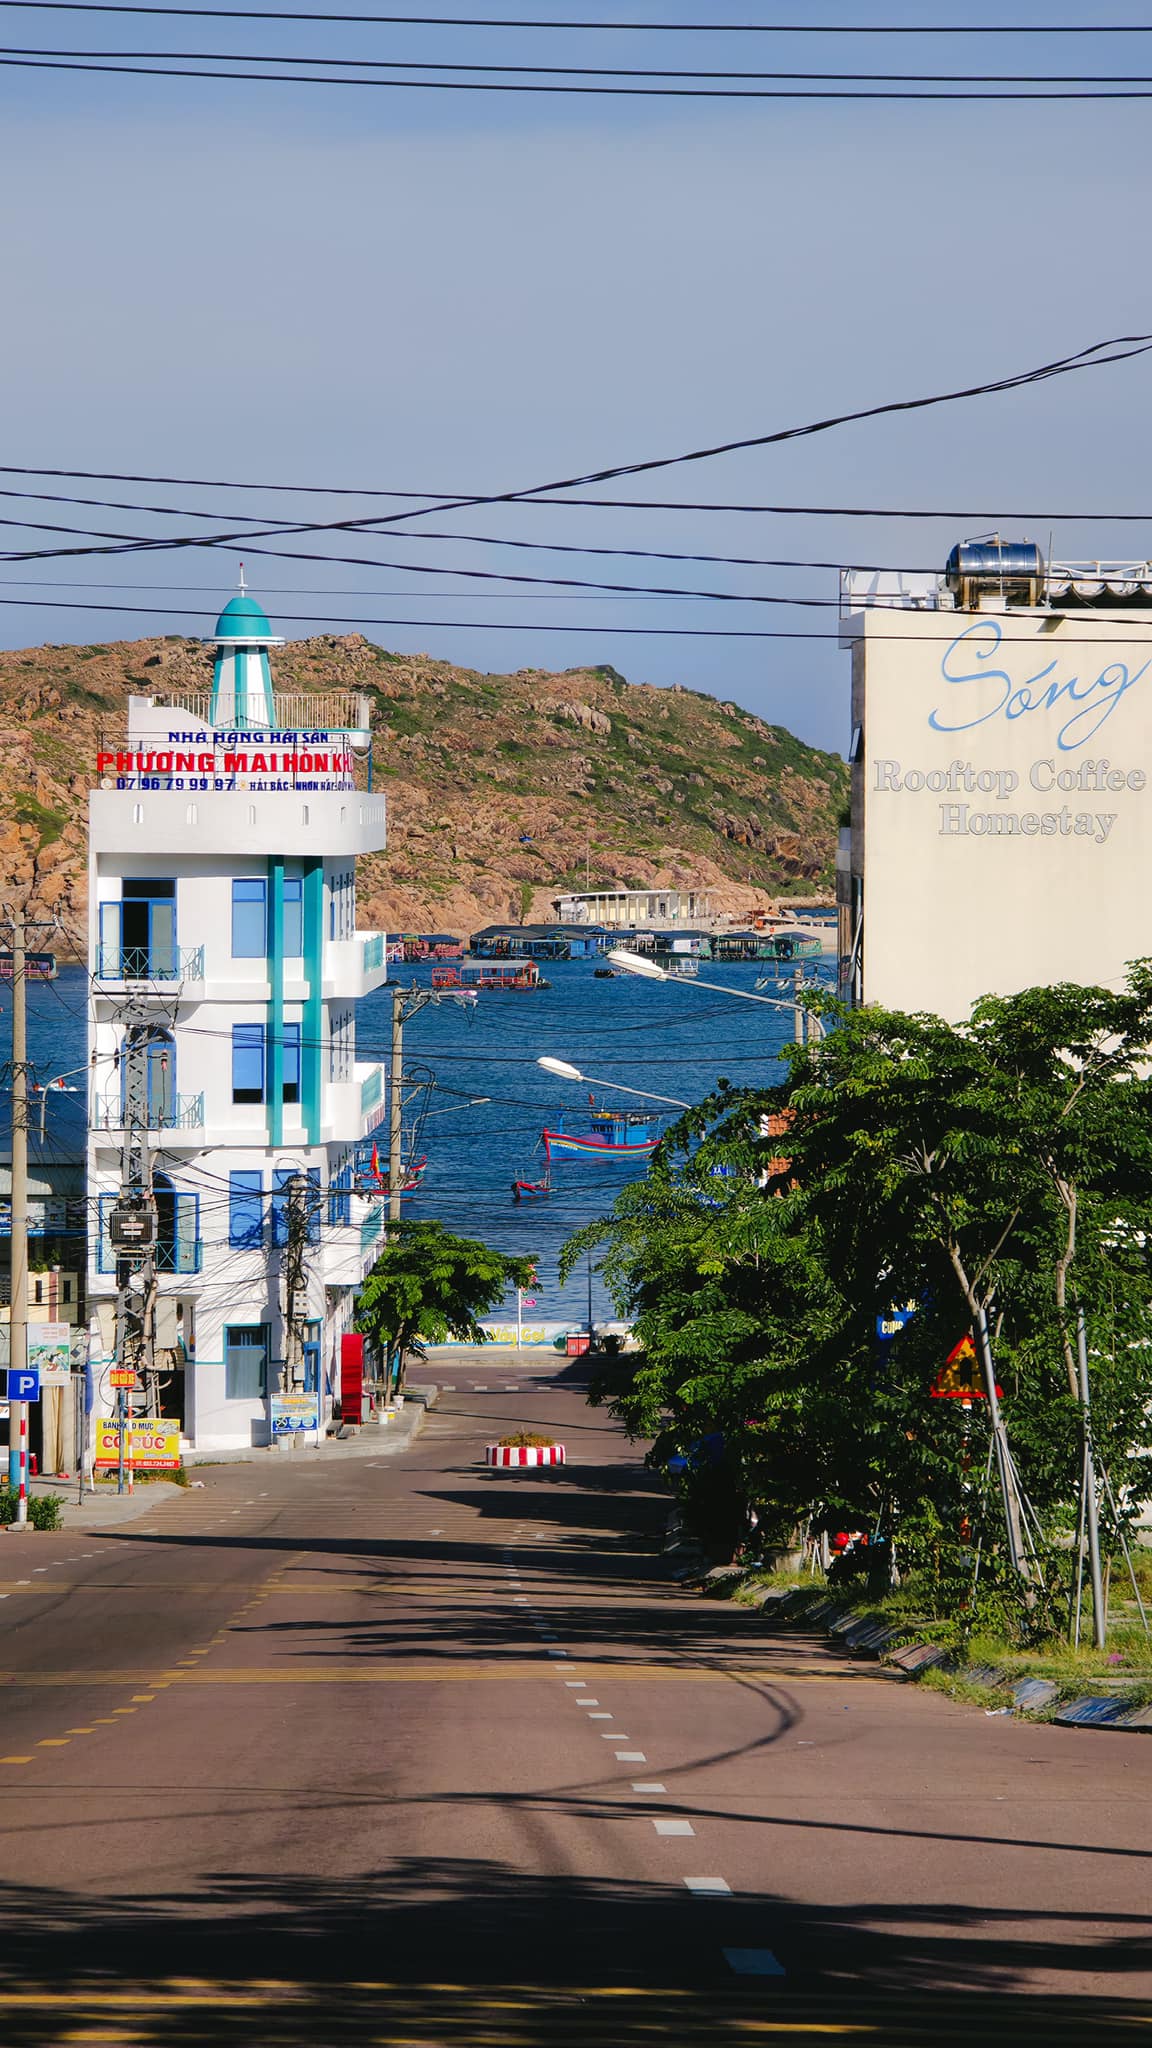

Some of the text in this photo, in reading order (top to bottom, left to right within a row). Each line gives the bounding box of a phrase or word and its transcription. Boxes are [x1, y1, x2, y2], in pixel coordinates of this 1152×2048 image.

[928, 620, 1151, 751] Sóng
[168, 728, 207, 743] NHÀ
[97, 751, 214, 773] PHƯƠNG
[223, 752, 277, 773] MAI
[283, 746, 328, 773] HÒN
[141, 777, 160, 790] 96
[164, 777, 184, 790] 79
[189, 778, 208, 790] 99
[215, 778, 235, 790] 97
[873, 759, 1147, 799] Rooftop Coffee
[938, 804, 1118, 843] Homestay
[19, 1376, 35, 1395] P
